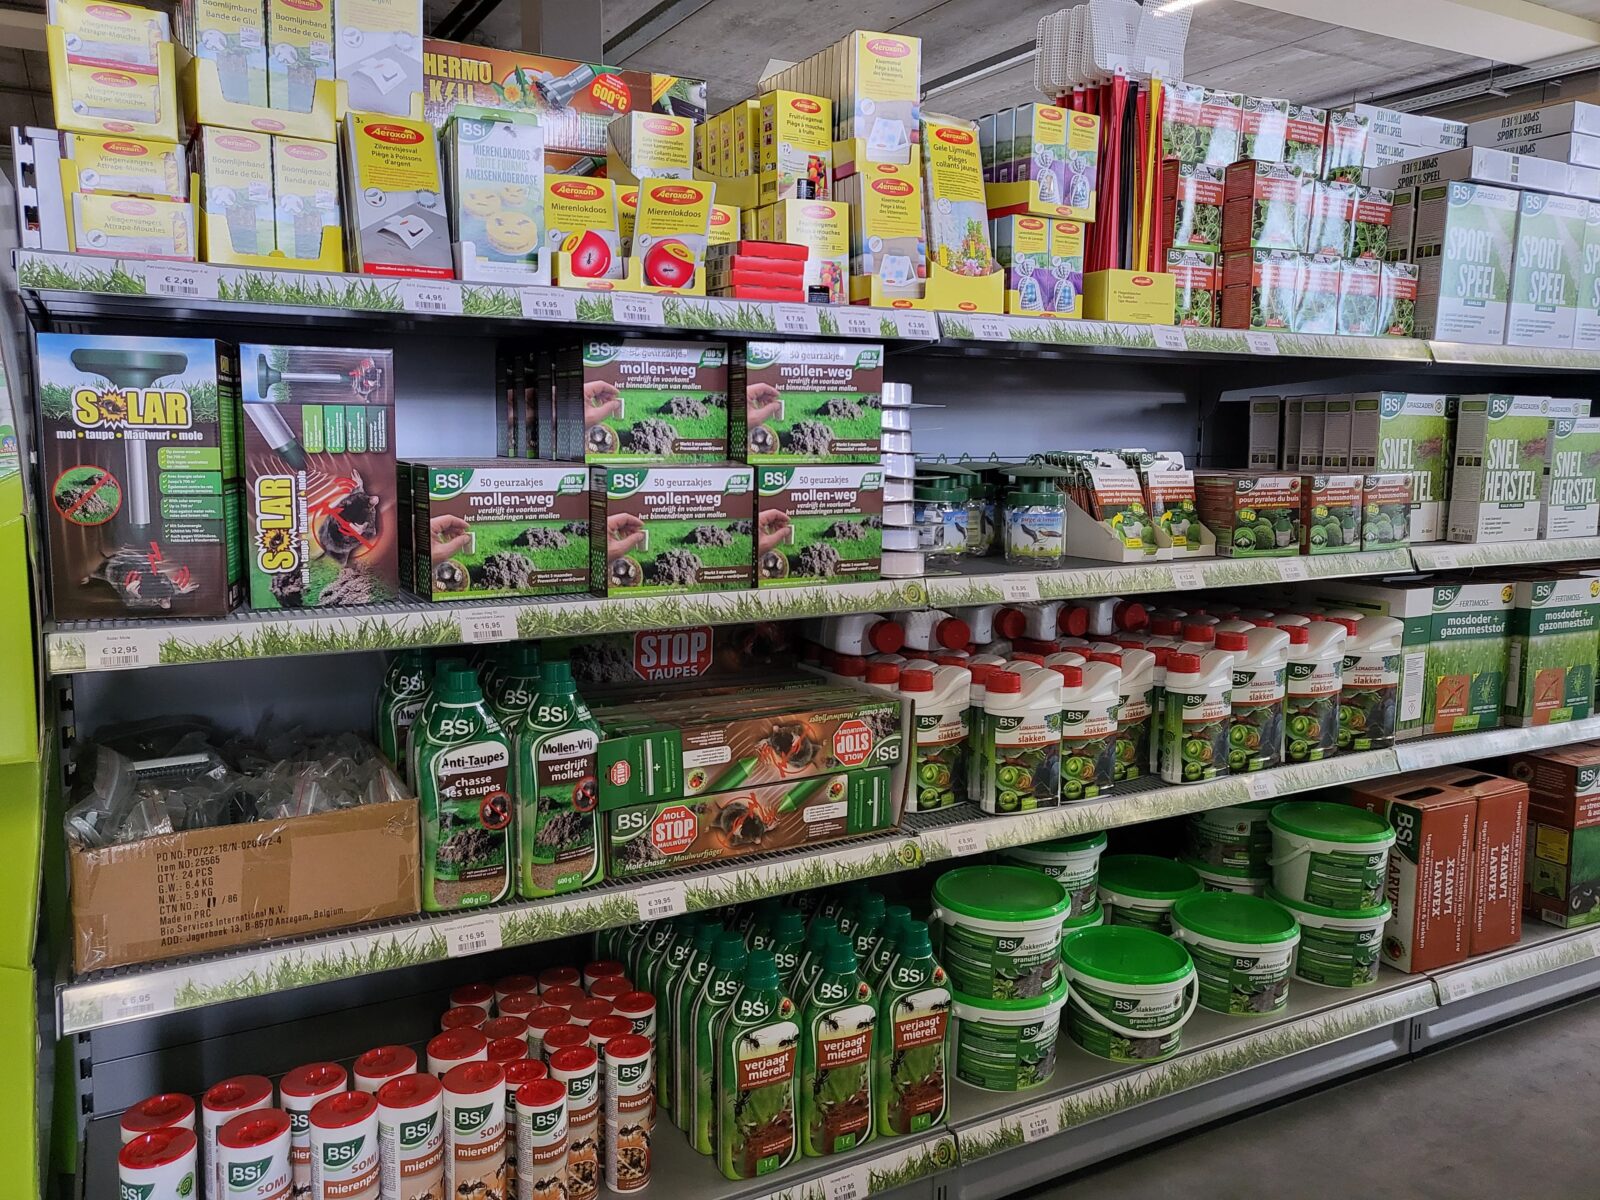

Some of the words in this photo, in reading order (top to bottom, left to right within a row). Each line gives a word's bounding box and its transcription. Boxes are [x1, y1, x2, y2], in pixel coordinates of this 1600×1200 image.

[276, 12, 327, 29] Boomlijmband
[940, 131, 970, 140] Aeroxon
[1497, 130, 1517, 141] SPORT
[1524, 126, 1542, 135] SPEEL
[375, 144, 417, 154] Zilvervisjesval
[473, 145, 530, 160] MIERENLOKDOOS
[372, 152, 388, 160] Piège
[396, 153, 422, 162] Poissons
[385, 159, 410, 168] d'argent
[948, 155, 967, 164] Pièges
[936, 161, 959, 170] collants
[960, 163, 978, 173] jaunes
[878, 182, 907, 191] Aeroxon
[657, 189, 695, 200] Aeroxon
[551, 203, 606, 214] Mierenlokdoos
[647, 208, 701, 218] Mierenlokdoos
[1448, 227, 1493, 264] SPORT
[1520, 235, 1565, 271] SPORT
[1457, 264, 1496, 299] SPEEL
[1529, 271, 1565, 305] SPEEL
[620, 362, 696, 377] mollen-weg
[781, 365, 853, 379] mollen-weg
[626, 383, 668, 391] binnendringen
[76, 390, 188, 425] SOLAR
[56, 430, 77, 440] mol
[86, 430, 115, 442] taupe
[124, 430, 170, 441] Maulwurf
[179, 430, 203, 441] mole
[1381, 438, 1414, 470] SNEL
[1488, 438, 1520, 469] SNEL
[1554, 451, 1582, 477] SNEL
[480, 479, 491, 487] 50
[494, 478, 543, 488] geurzakjes
[654, 478, 665, 486] 50
[667, 478, 712, 488] geurzakjes
[800, 476, 808, 484] 50
[810, 476, 849, 486] geurzakjes
[1485, 471, 1537, 501] HERSTEL
[791, 489, 857, 502] mollen-weg
[1552, 478, 1597, 503] HERSTEL
[470, 493, 554, 506] mollen-weg
[644, 493, 721, 506] mollen-weg
[261, 478, 294, 571] SOLAR
[477, 514, 524, 522] binnendringen
[1448, 614, 1491, 625] mosdoder
[1539, 617, 1593, 632] gazonmeststof
[1441, 622, 1505, 638] gazonmeststof
[102, 647, 108, 655] €
[111, 645, 138, 655] 32,95
[641, 631, 706, 666] STOP
[647, 666, 698, 680] TAUPES
[1354, 676, 1382, 684] slakken
[1310, 684, 1333, 692] slakken
[1250, 692, 1274, 701] slakken
[1125, 710, 1145, 718] slakken
[1202, 709, 1223, 718] slakken
[937, 730, 961, 740] slakken
[1084, 726, 1108, 734] slakken
[836, 735, 869, 753] STOP
[1018, 734, 1046, 743] slakken
[542, 737, 592, 755] Mollen-Vrij
[442, 751, 504, 769] Anti-Taupes
[844, 752, 863, 761] MOLE
[549, 758, 587, 772] verdrijft
[455, 775, 492, 787] chasse
[551, 768, 585, 781] mollen
[447, 787, 463, 798] les
[464, 783, 500, 796] taupes
[663, 811, 685, 820] MOLE
[656, 820, 694, 841] STOP
[625, 861, 642, 871] Mole
[644, 858, 666, 868] chaser
[673, 848, 724, 862] Maulwurfjäger
[158, 875, 178, 883] QTY:
[183, 871, 193, 879] 24
[196, 868, 213, 876] PCS
[1063, 869, 1092, 878] slakkenvraat
[1488, 846, 1498, 901] LARVEX
[1500, 844, 1509, 899] LARVEX
[186, 880, 199, 889] 6.4
[202, 878, 214, 886] KG
[1432, 860, 1443, 918] LARVEX
[1444, 856, 1455, 915] LARVEX
[655, 896, 671, 905] 39,95
[160, 916, 181, 925] Made
[194, 909, 211, 919] PRC
[466, 931, 485, 939] 16,95
[1020, 939, 1054, 950] slakkenvraat
[1013, 955, 1039, 964] granulés
[1236, 959, 1252, 968] BSi
[1255, 961, 1286, 970] slakkenvraat
[899, 968, 924, 982] BSi
[821, 984, 847, 999] BSi
[741, 1001, 769, 1017] BSi
[1136, 1003, 1172, 1012] slakkenvraat
[900, 1016, 941, 1033] verjaagt
[1023, 1027, 1038, 1036] BSi
[904, 1026, 937, 1041] mieren
[824, 1034, 866, 1053] verjaagt
[827, 1046, 863, 1061] mieren
[745, 1052, 789, 1072] verjaagt
[749, 1065, 785, 1080] mieren
[352, 1152, 377, 1173] SOMI
[257, 1175, 287, 1196] SOMI
